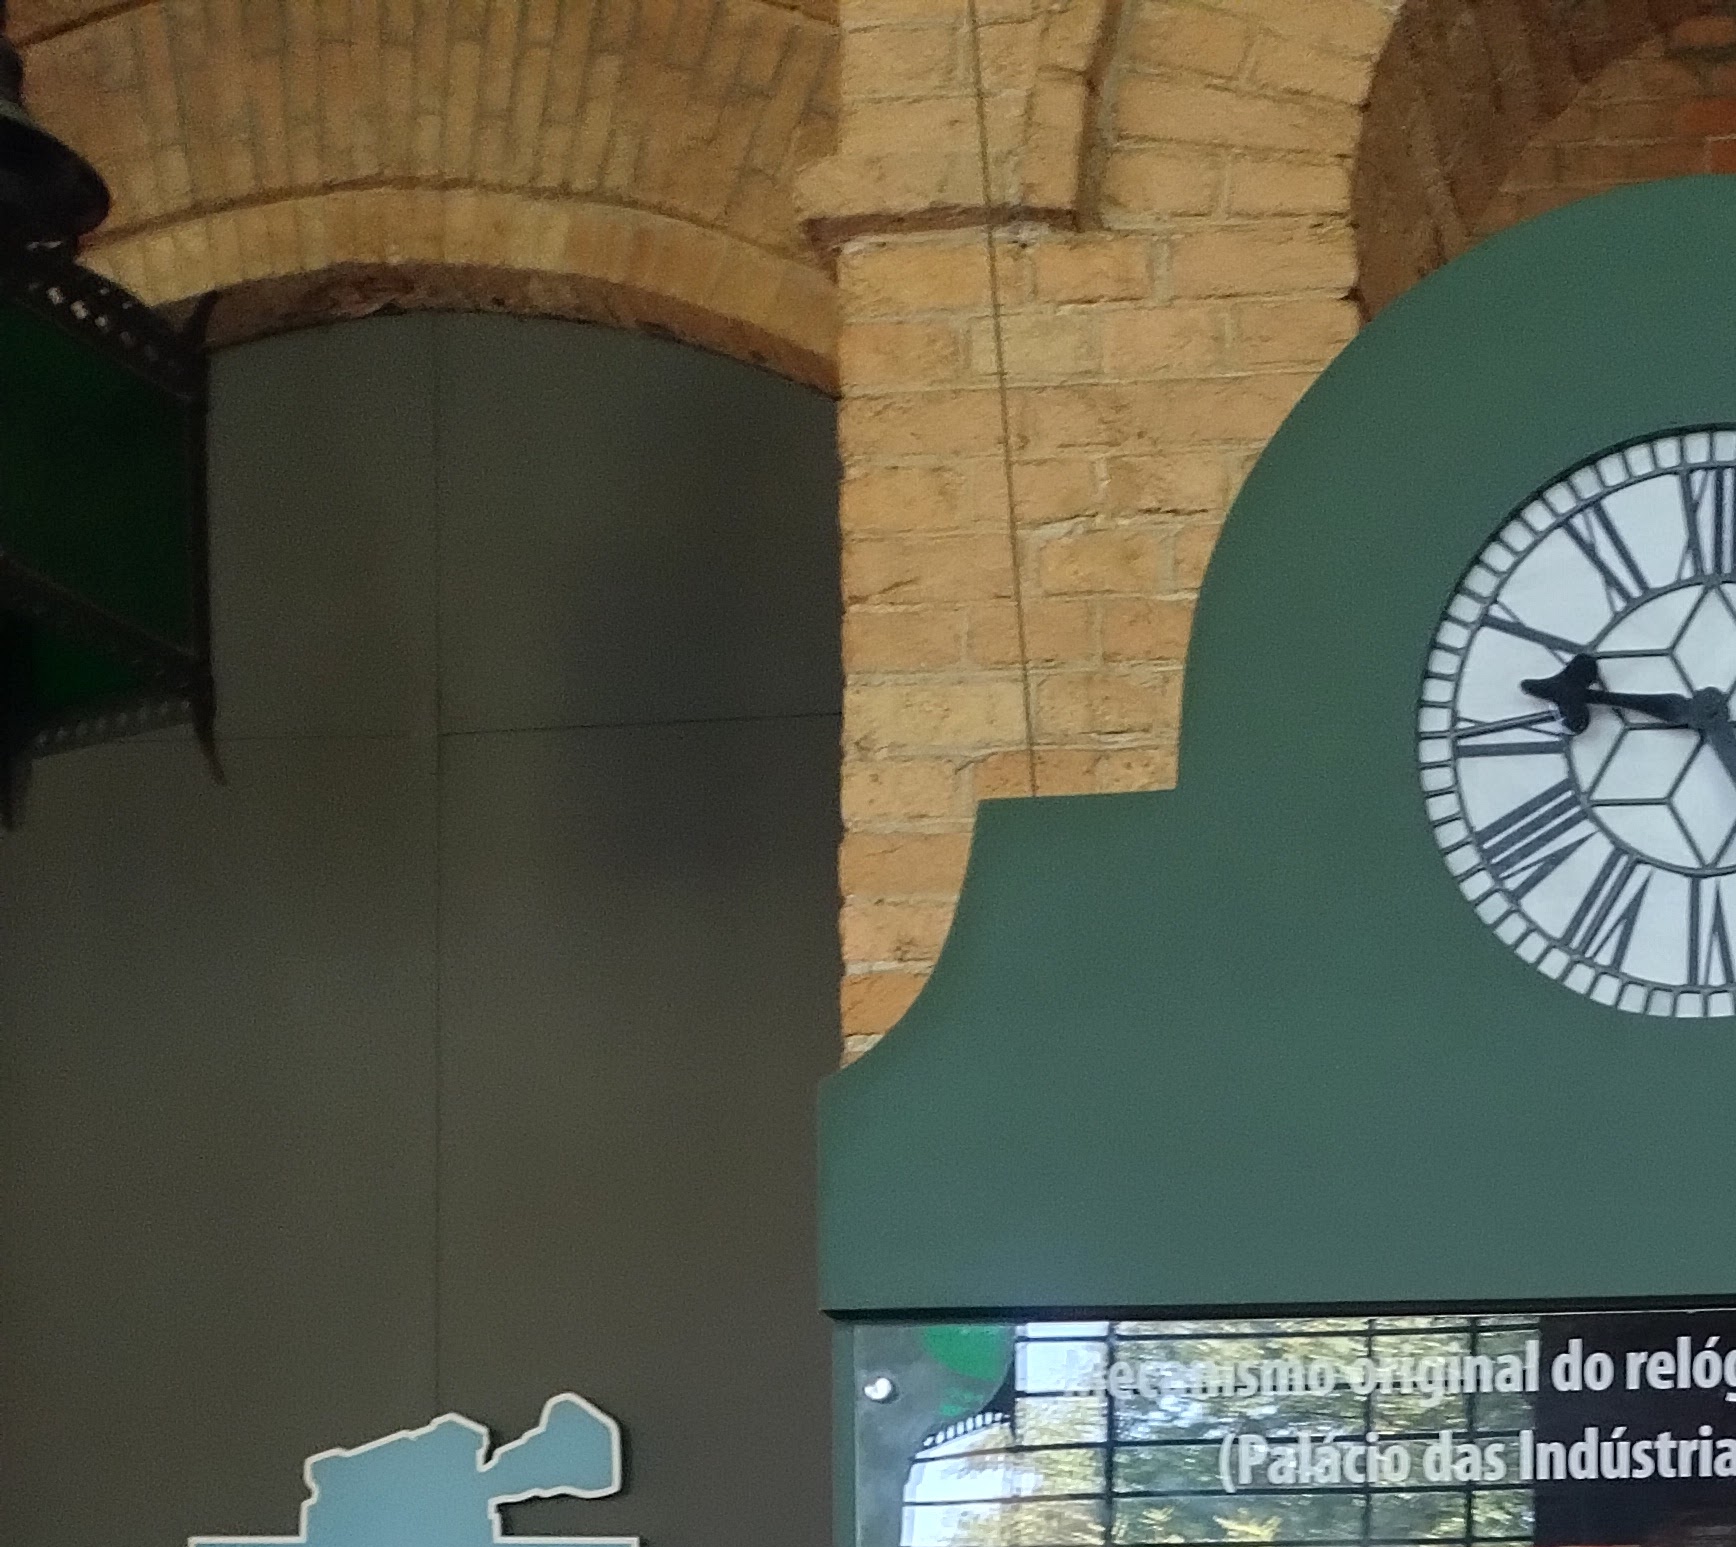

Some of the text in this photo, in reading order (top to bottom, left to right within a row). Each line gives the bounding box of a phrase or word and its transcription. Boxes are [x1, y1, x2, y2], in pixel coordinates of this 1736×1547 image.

[1356, 1339, 1540, 1408] original
[1552, 1338, 1614, 1391] do
[1219, 1430, 1411, 1494] (Palácio
[1422, 1429, 1507, 1482] das
